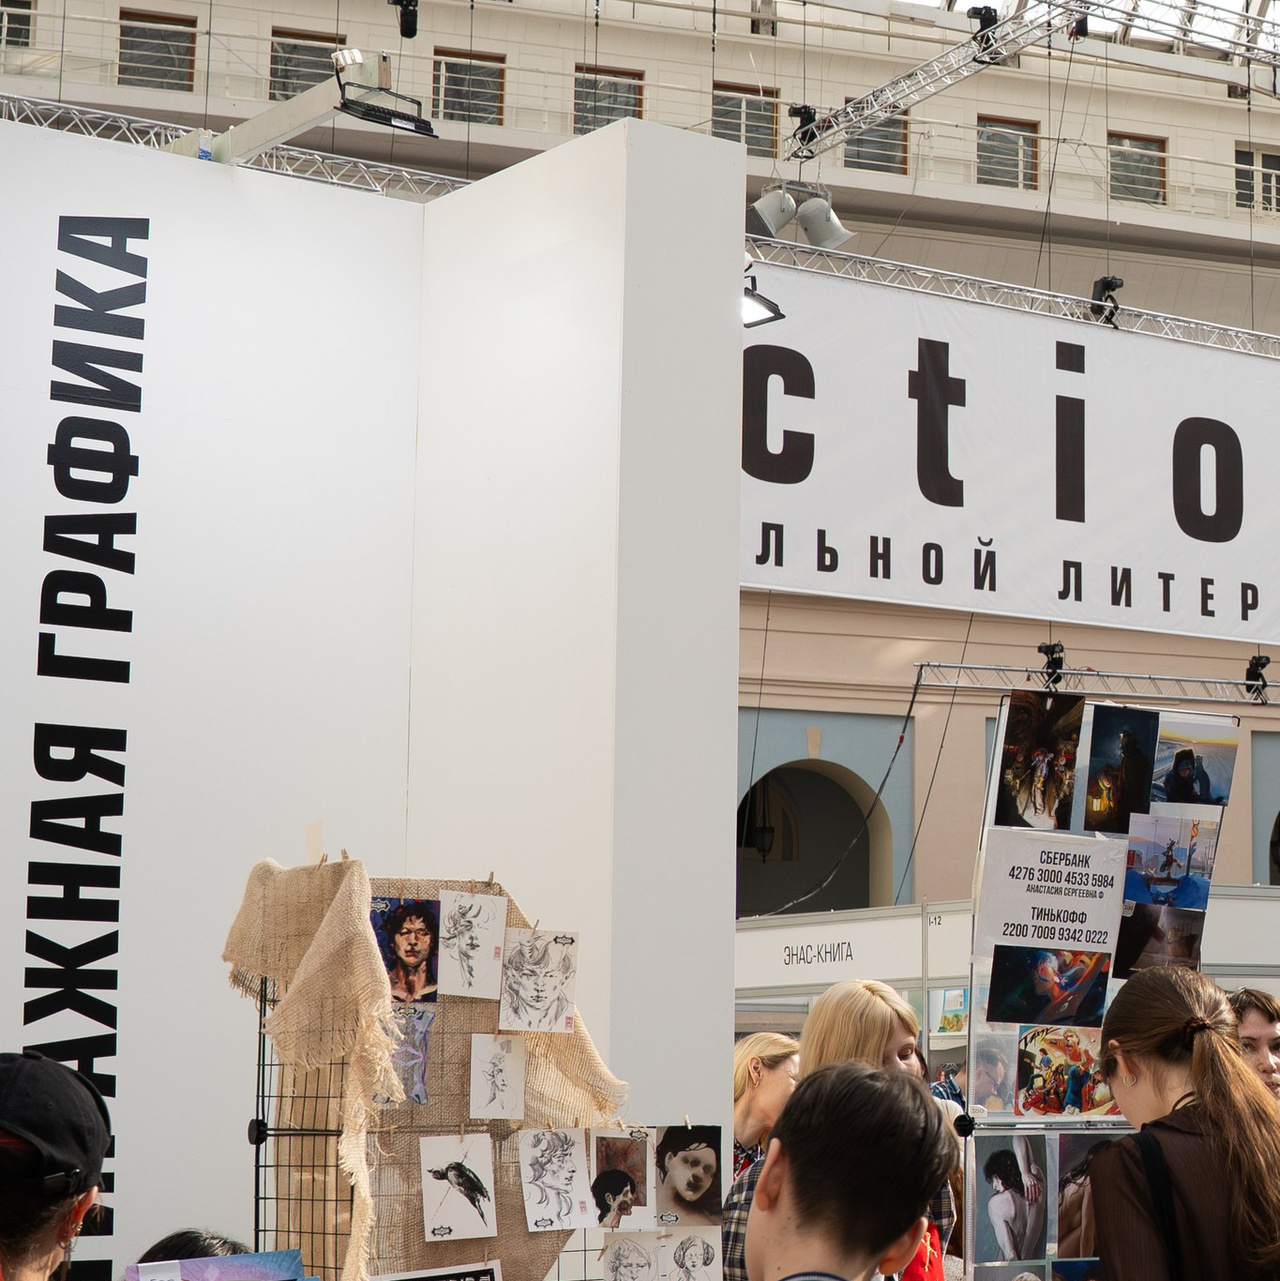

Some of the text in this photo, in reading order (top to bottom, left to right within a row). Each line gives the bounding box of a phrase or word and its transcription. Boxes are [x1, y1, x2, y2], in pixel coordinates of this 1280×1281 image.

[37, 215, 150, 683] ГРАФИКА
[755, 522, 997, 593] ЛЬНОЙ
[1039, 850, 1092, 869] СБЕРБАНК
[1008, 865, 1115, 889] 4276 3000 4533 5984
[1025, 883, 1104, 899] АНАСТАСИЯ СЕРГЕЕВНА Ф
[1030, 906, 1088, 925] ТИНЬКОФФ
[1002, 922, 1109, 945] 2200 7009 9342 0222
[783, 941, 854, 966] ЭНАС-КНИГА
